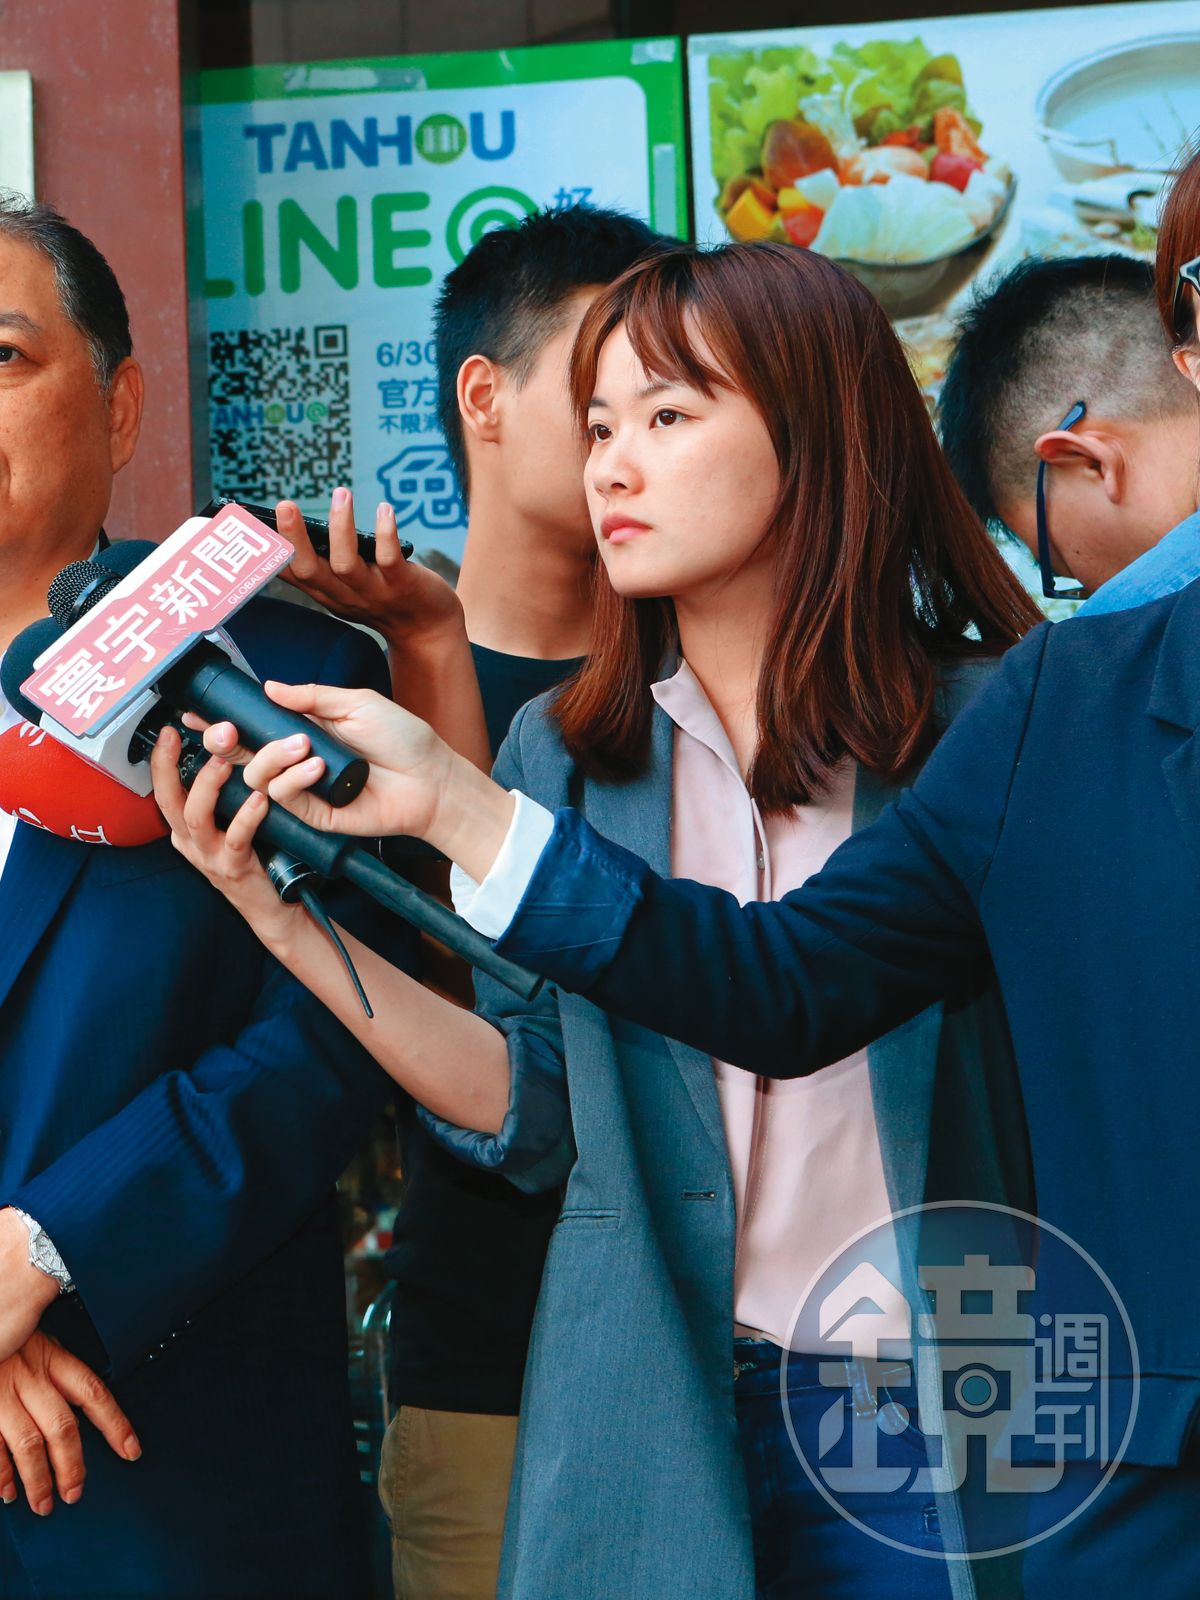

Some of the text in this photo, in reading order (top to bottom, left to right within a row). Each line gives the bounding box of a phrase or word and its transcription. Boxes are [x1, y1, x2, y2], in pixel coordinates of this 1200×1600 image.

[244, 110, 515, 174] TANHOU
[377, 378, 439, 408] 官方
[227, 547, 289, 605] GLOBAL NEWS
[38, 514, 272, 719] 寰宇新聞
